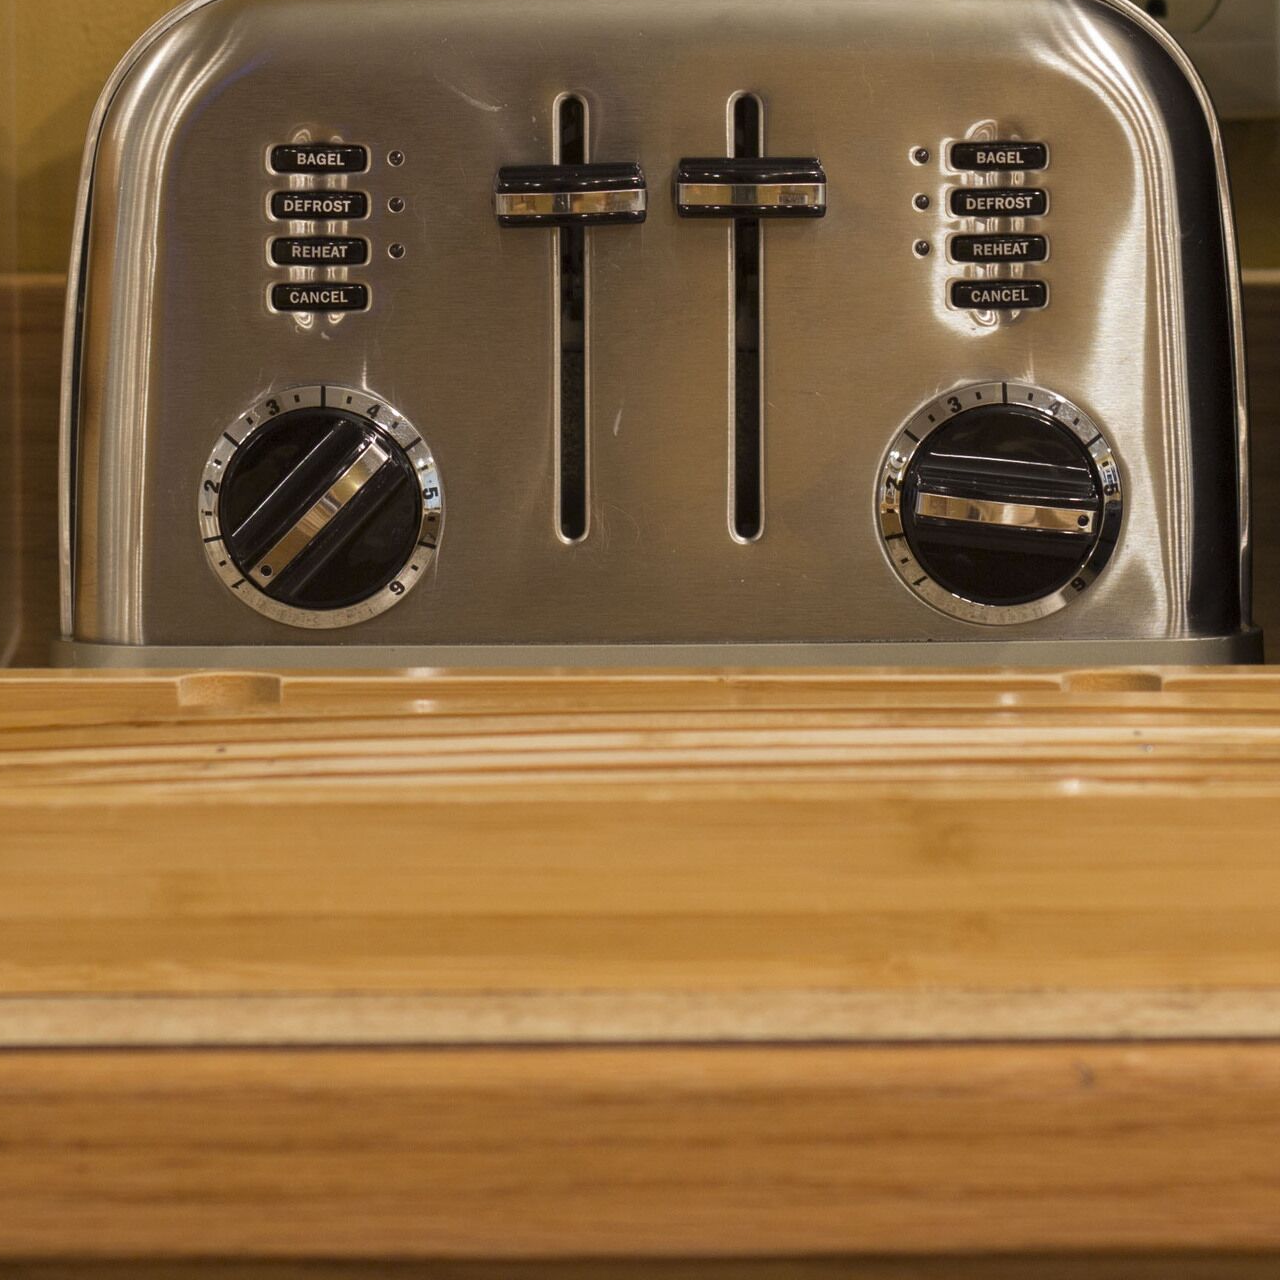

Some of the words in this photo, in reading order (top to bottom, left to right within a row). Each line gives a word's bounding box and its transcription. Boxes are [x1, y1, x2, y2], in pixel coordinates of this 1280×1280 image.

[297, 153, 345, 166] BAGEL
[976, 151, 1024, 164] BAGEL
[284, 199, 352, 212] DEFROST
[966, 197, 1033, 210] DEFROST
[292, 245, 348, 258] REHEAT
[973, 242, 1029, 256] REHEAT
[289, 290, 349, 304] CANCEL
[971, 289, 1030, 303] CANCEL
[265, 399, 281, 416] 3
[366, 404, 380, 419] 4
[947, 396, 962, 413] 3
[1047, 401, 1060, 416] 4
[204, 479, 220, 494] 2
[423, 486, 439, 500] 5
